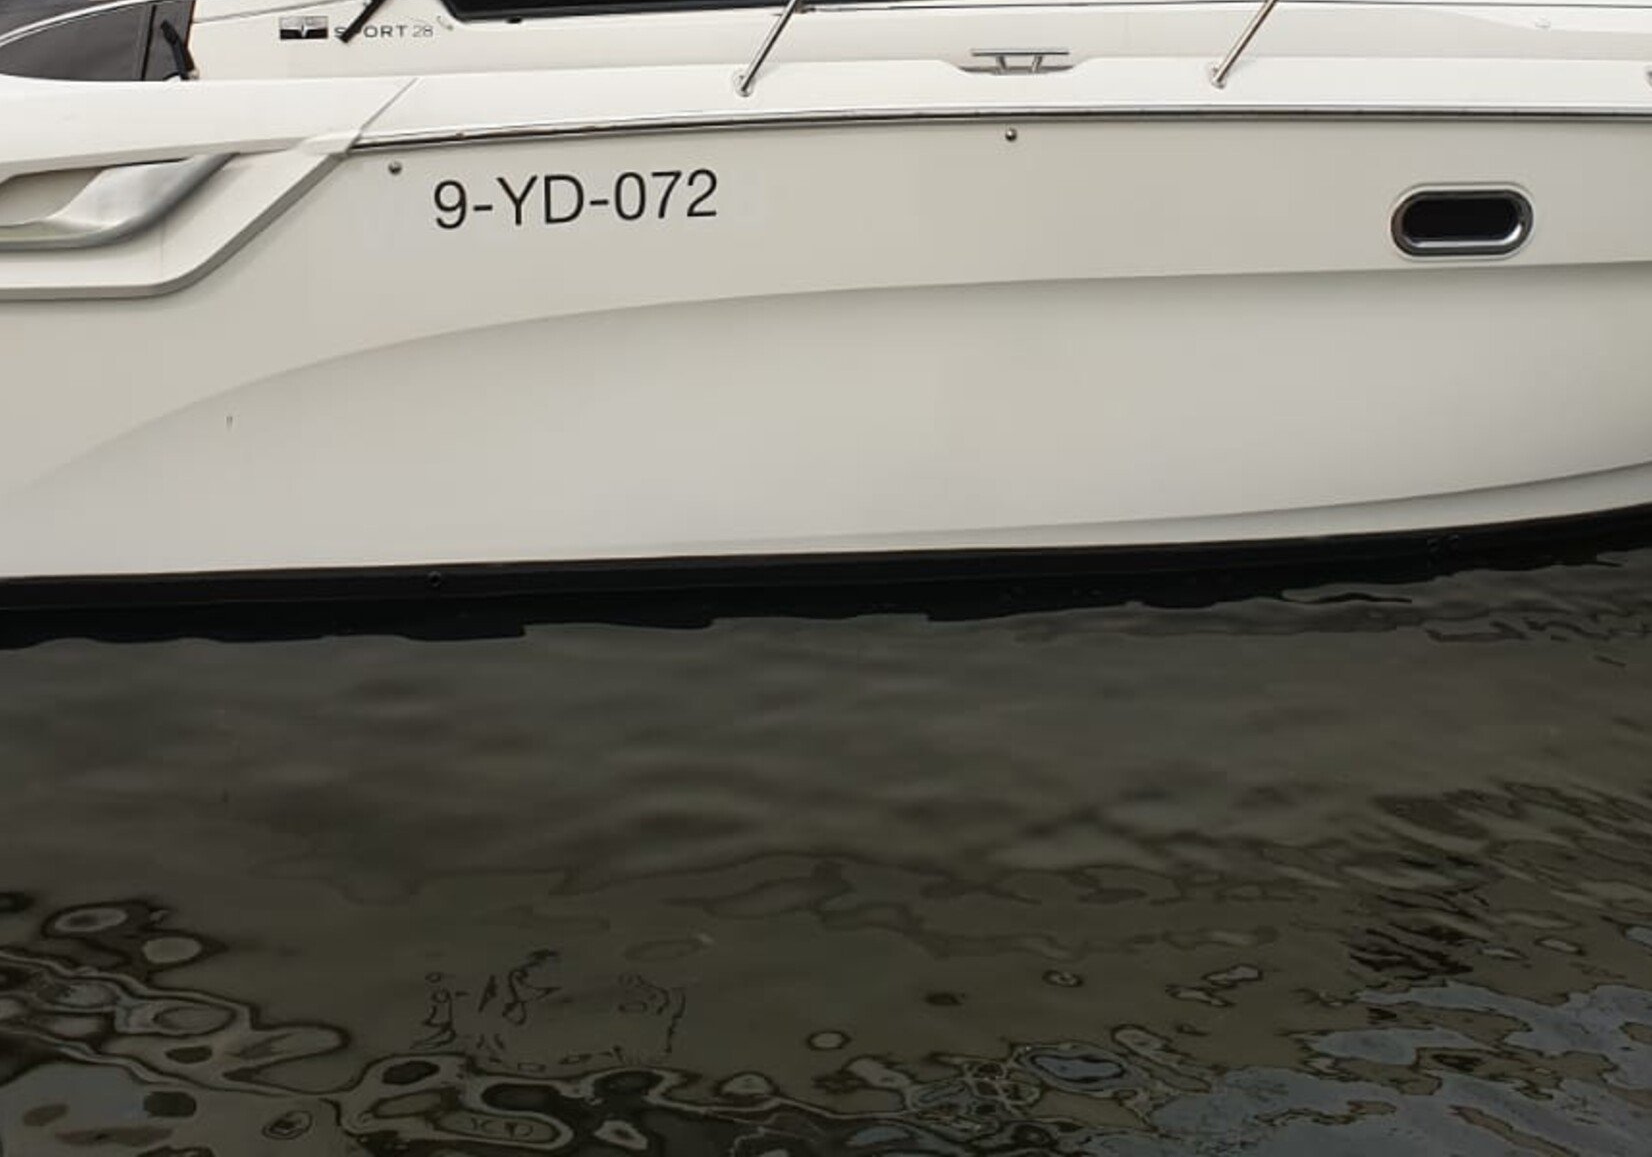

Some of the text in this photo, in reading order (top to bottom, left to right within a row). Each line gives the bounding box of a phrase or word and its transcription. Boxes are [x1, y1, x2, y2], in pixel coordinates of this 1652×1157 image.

[334, 24, 434, 39] SORT 28
[434, 169, 718, 230] 9-YD-072
